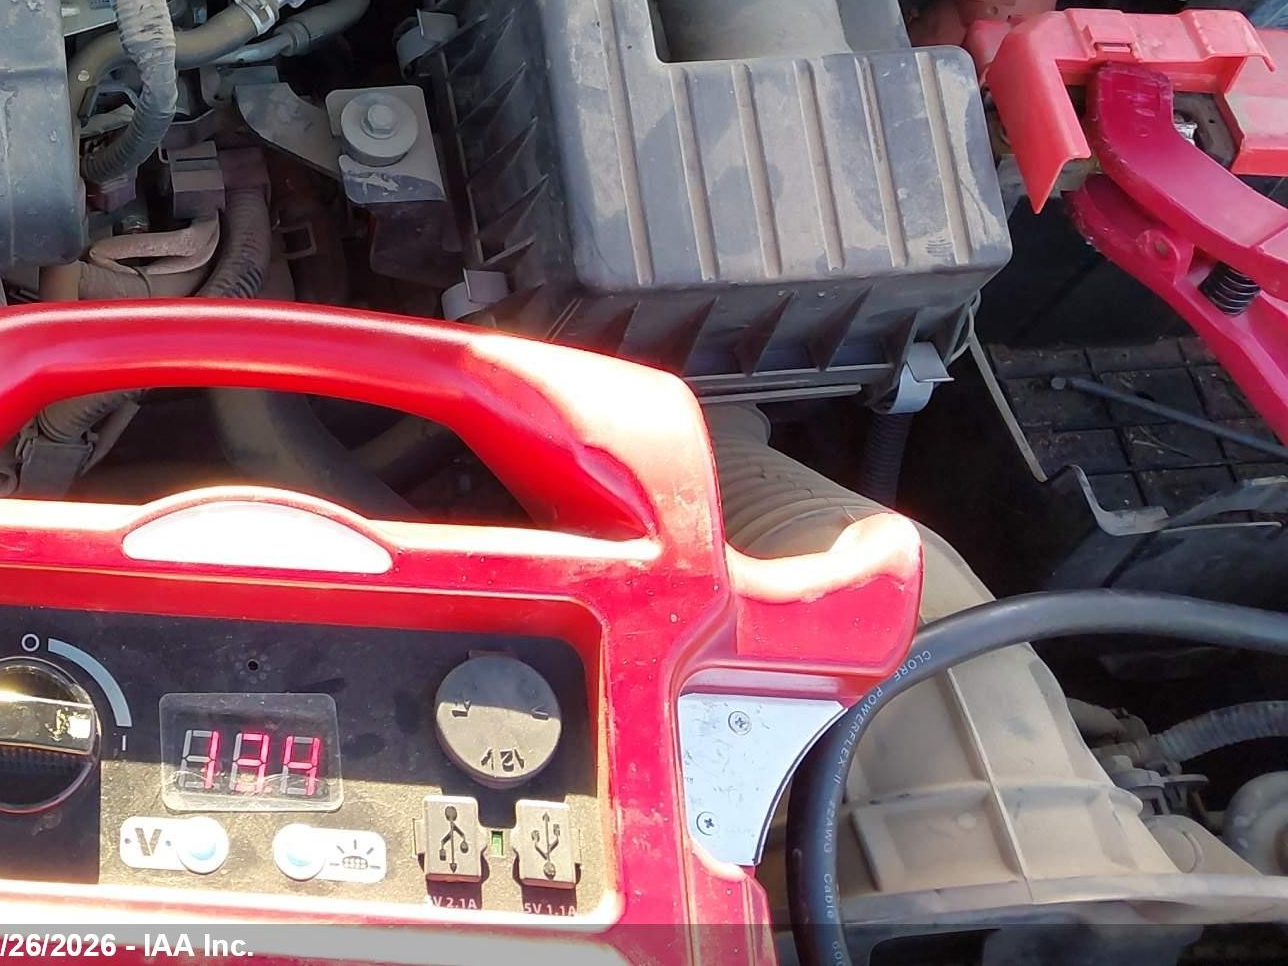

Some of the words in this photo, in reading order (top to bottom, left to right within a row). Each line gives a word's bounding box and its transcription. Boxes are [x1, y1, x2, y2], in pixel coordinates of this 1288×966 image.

[893, 650, 932, 683] CLORE
[445, 897, 478, 910] 2.1A
[823, 873, 835, 919] Cable
[523, 902, 542, 915] 5V
[546, 904, 577, 917] 1.1A
